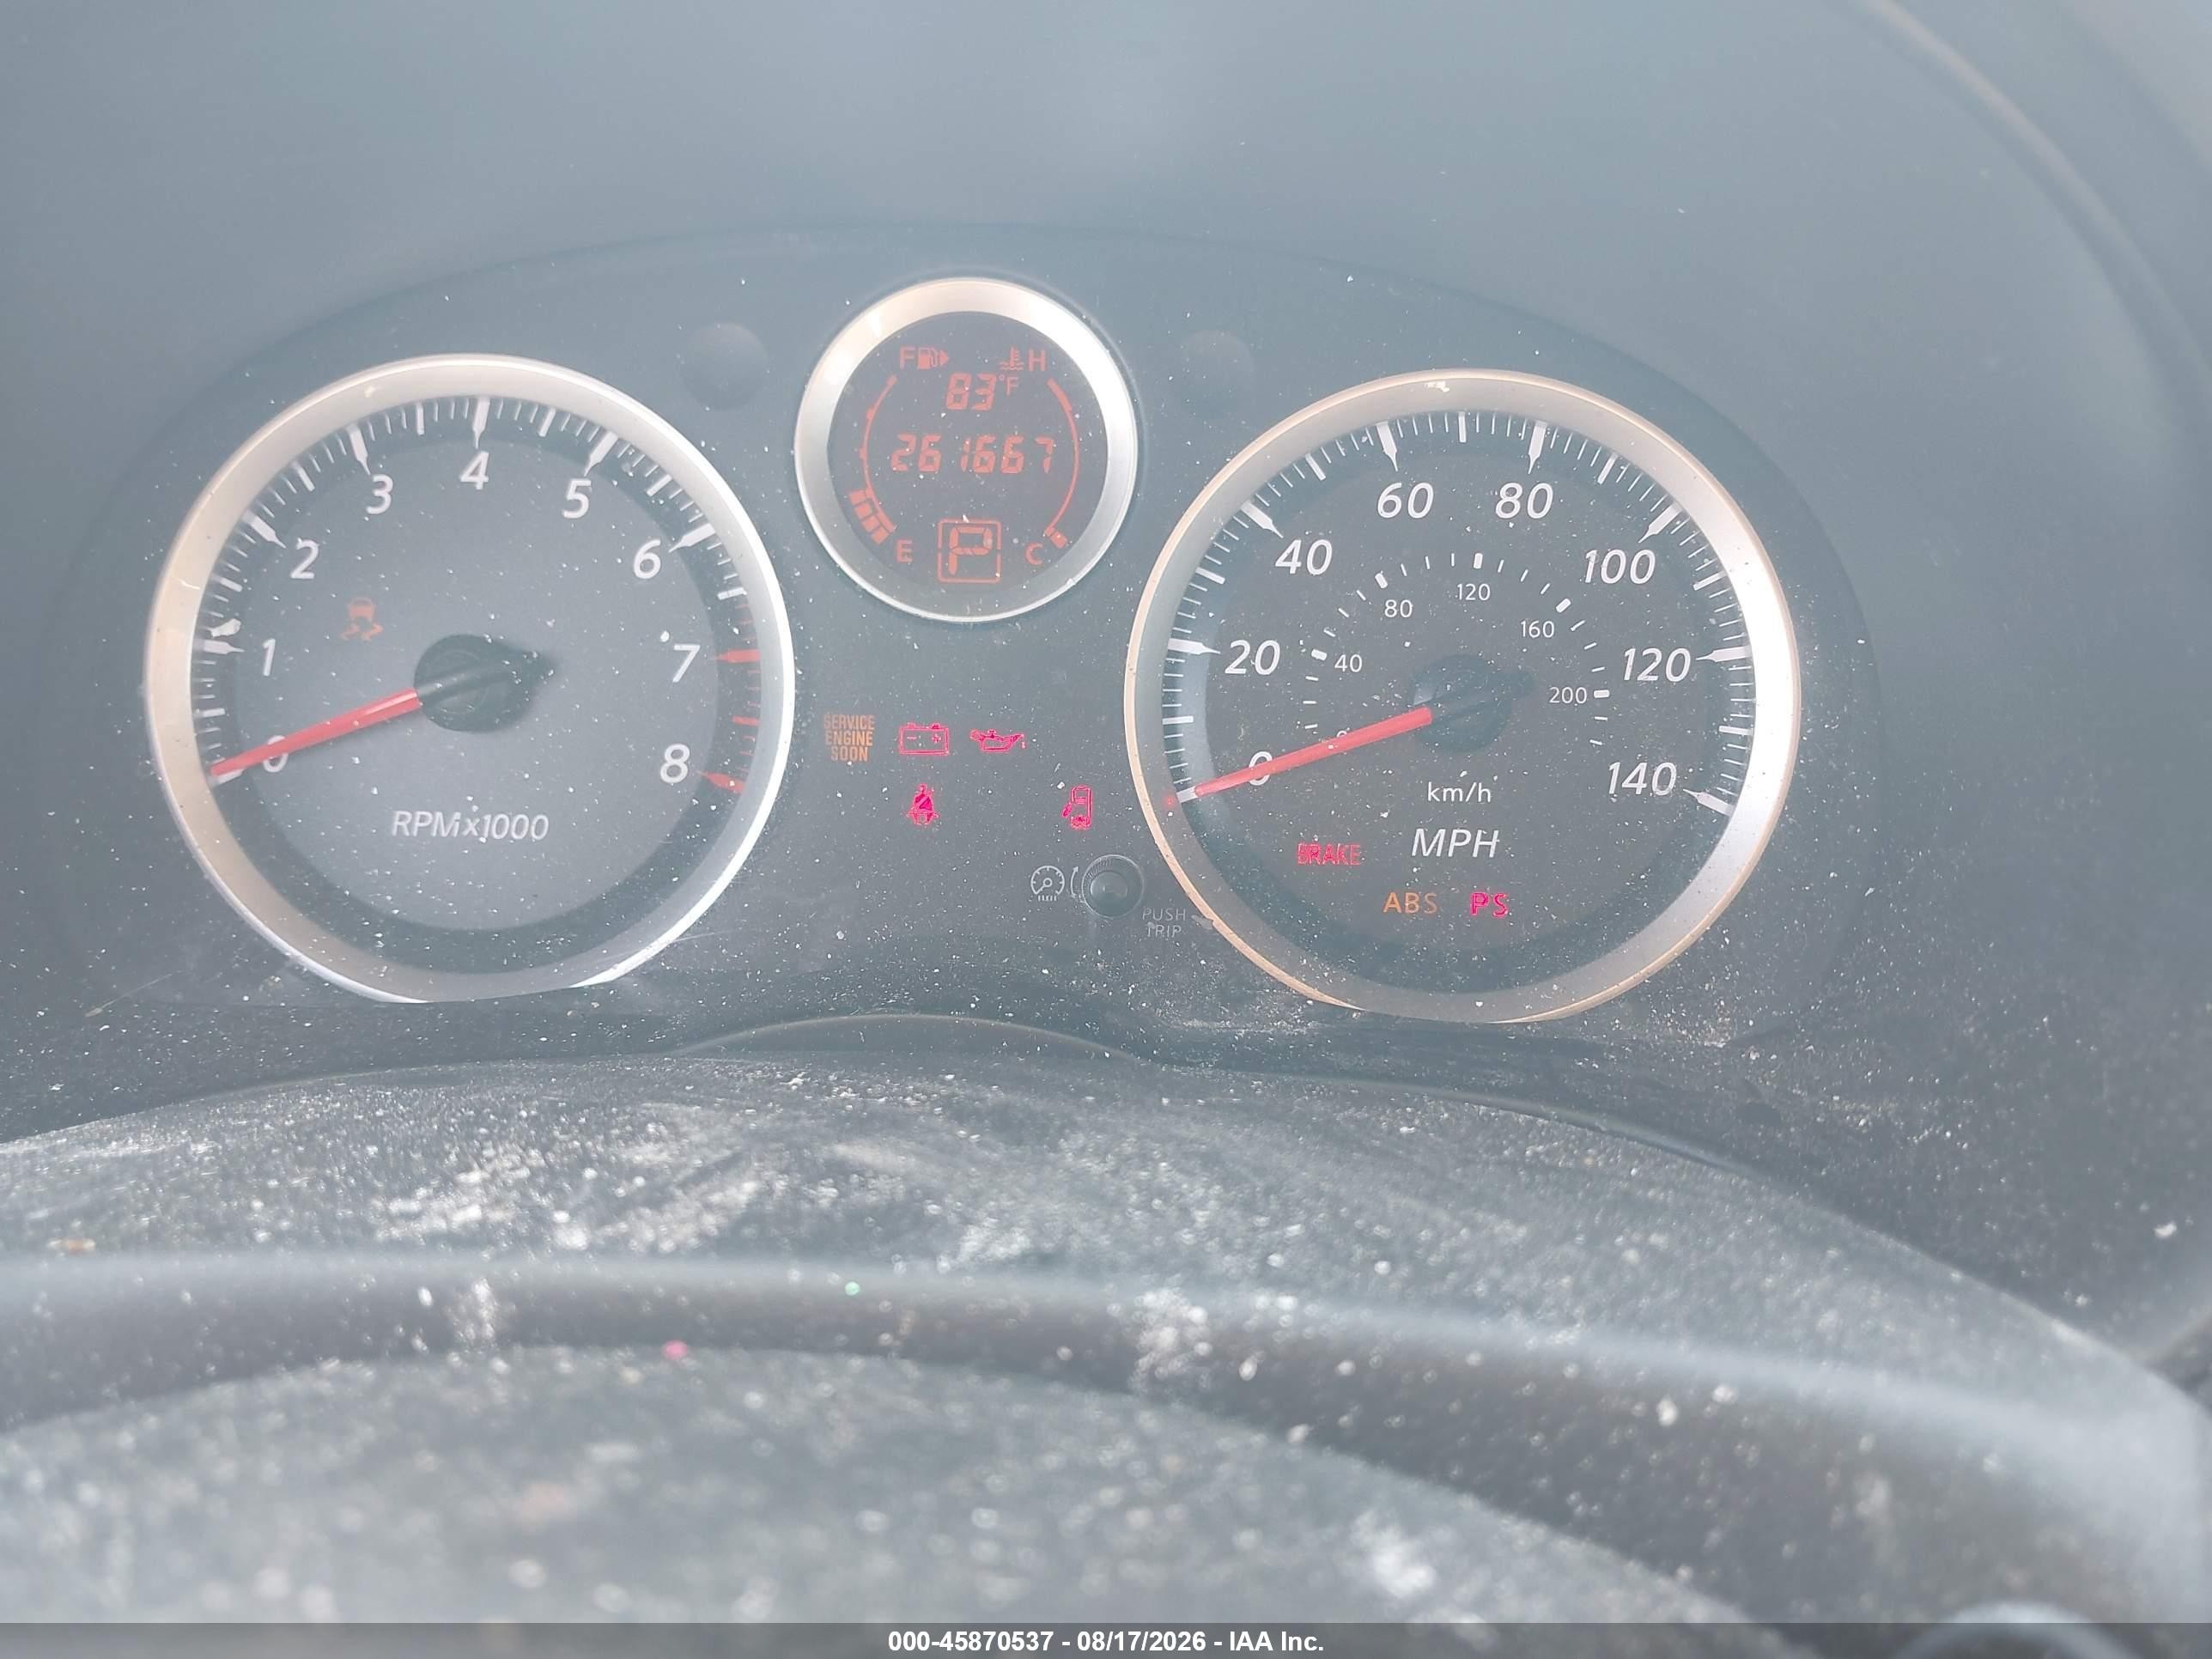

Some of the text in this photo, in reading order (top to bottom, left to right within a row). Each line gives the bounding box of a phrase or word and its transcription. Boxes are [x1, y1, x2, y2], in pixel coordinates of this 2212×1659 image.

[899, 347, 915, 370] F
[1029, 349, 1047, 372] H
[890, 434, 1055, 474] 261667
[460, 451, 489, 489] 4
[367, 475, 394, 515] 3
[562, 478, 592, 519] 5
[1376, 482, 1435, 519] 60
[1495, 482, 1553, 519] 80
[290, 539, 319, 580] 2
[633, 539, 662, 580] 6
[896, 539, 913, 563] E
[948, 526, 993, 575] P
[1025, 543, 1043, 565] C
[1275, 539, 1333, 575] 40
[1583, 549, 1656, 585] 100
[1456, 584, 1491, 600] 120
[1384, 599, 1413, 617] 80
[1521, 622, 1555, 639] 160
[262, 638, 276, 676] 1
[672, 645, 700, 682] 7
[1224, 640, 1280, 676] 20
[1334, 654, 1363, 672] 40
[1623, 647, 1691, 683] 120
[1549, 687, 1587, 704] 200
[824, 714, 874, 730] SERVICE
[825, 731, 873, 745] ENGINE
[659, 744, 690, 783] 8
[830, 746, 868, 762] SOON
[1608, 762, 1677, 797] 140
[1427, 782, 1492, 805] km/h
[1297, 843, 1361, 866] BRAKE
[1412, 829, 1500, 858] MPH
[1143, 907, 1187, 922] PUSH
[1382, 891, 1438, 915] ABS
[1470, 892, 1509, 917] PS
[1146, 925, 1182, 939] TRIP
